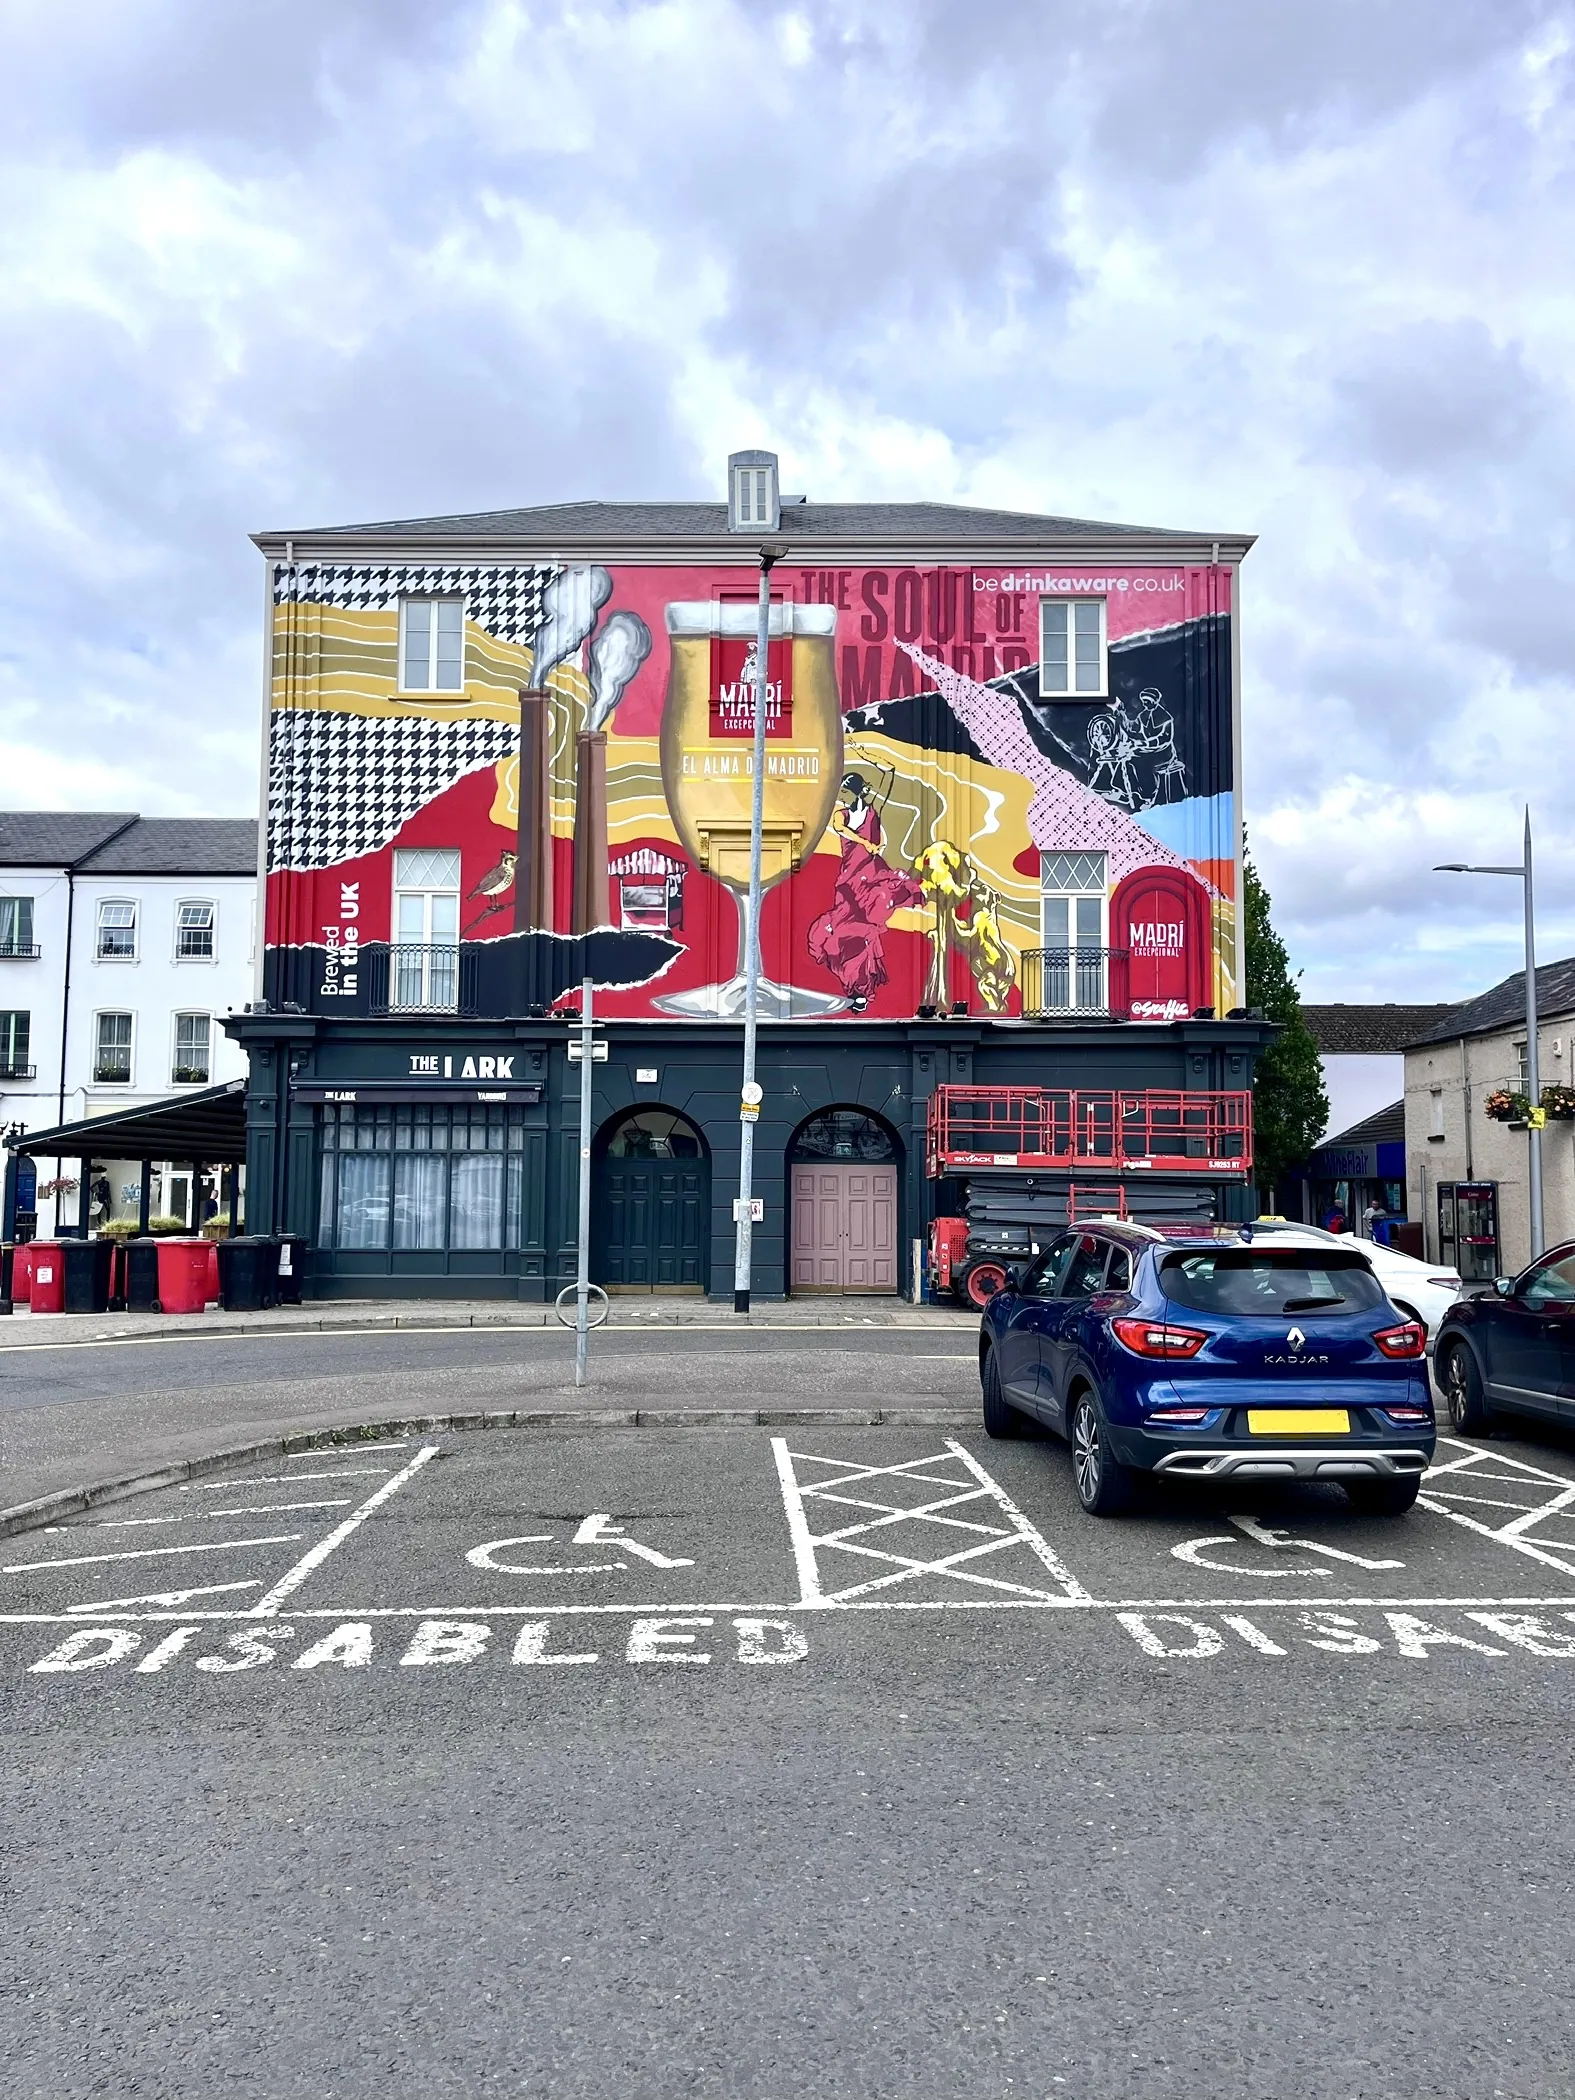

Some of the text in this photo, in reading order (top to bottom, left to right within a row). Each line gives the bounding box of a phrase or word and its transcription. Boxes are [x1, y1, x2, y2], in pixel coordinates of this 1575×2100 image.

[1000, 572, 1130, 592] drinkaware
[801, 570, 1027, 645] THE SOUL OF
[724, 718, 776, 730] EXCEPCIAL
[682, 755, 697, 775] EL
[703, 756, 739, 775] ALMA
[768, 757, 820, 776] MADRID
[338, 881, 360, 996] in the UK
[1129, 920, 1184, 948] MADRÍ
[320, 926, 340, 996] Brewed
[1134, 948, 1181, 958] EXCEPCIONAL
[409, 1055, 440, 1071] THE
[334, 1091, 357, 1101] LARK
[953, 1155, 992, 1164] SKYJACK
[1264, 1355, 1329, 1364] KADJAR
[1115, 1610, 1575, 1659] DISAB
[25, 1616, 810, 1674] DISABLED
